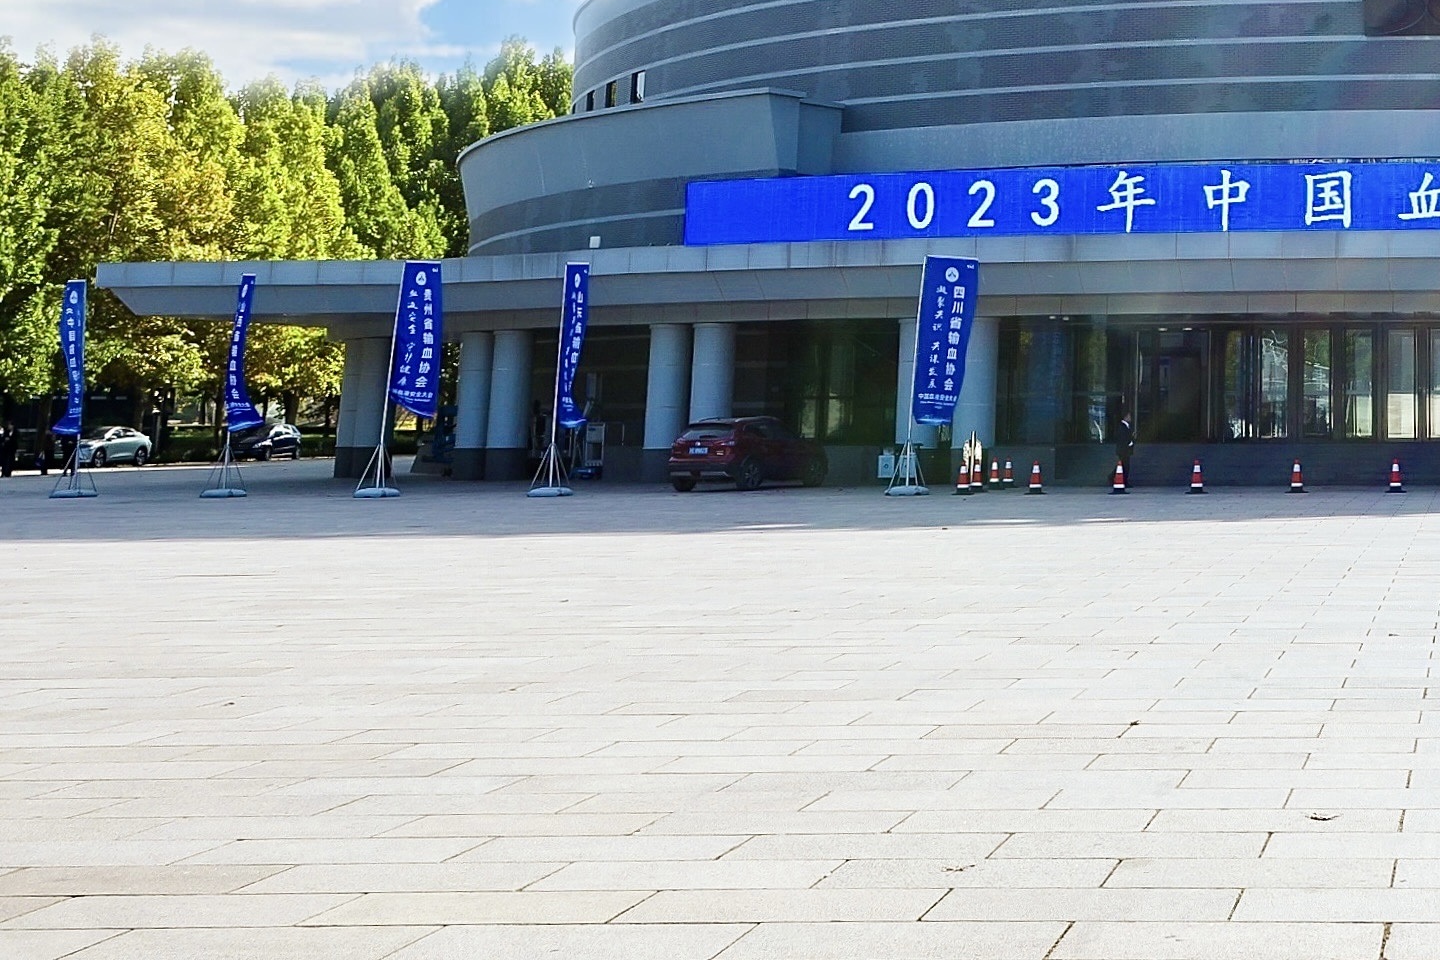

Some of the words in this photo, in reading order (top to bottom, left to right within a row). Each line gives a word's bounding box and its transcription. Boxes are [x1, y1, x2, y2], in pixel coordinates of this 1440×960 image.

[415, 289, 434, 388] 贵州省输血协会
[944, 286, 965, 391] 四川省输血协会
